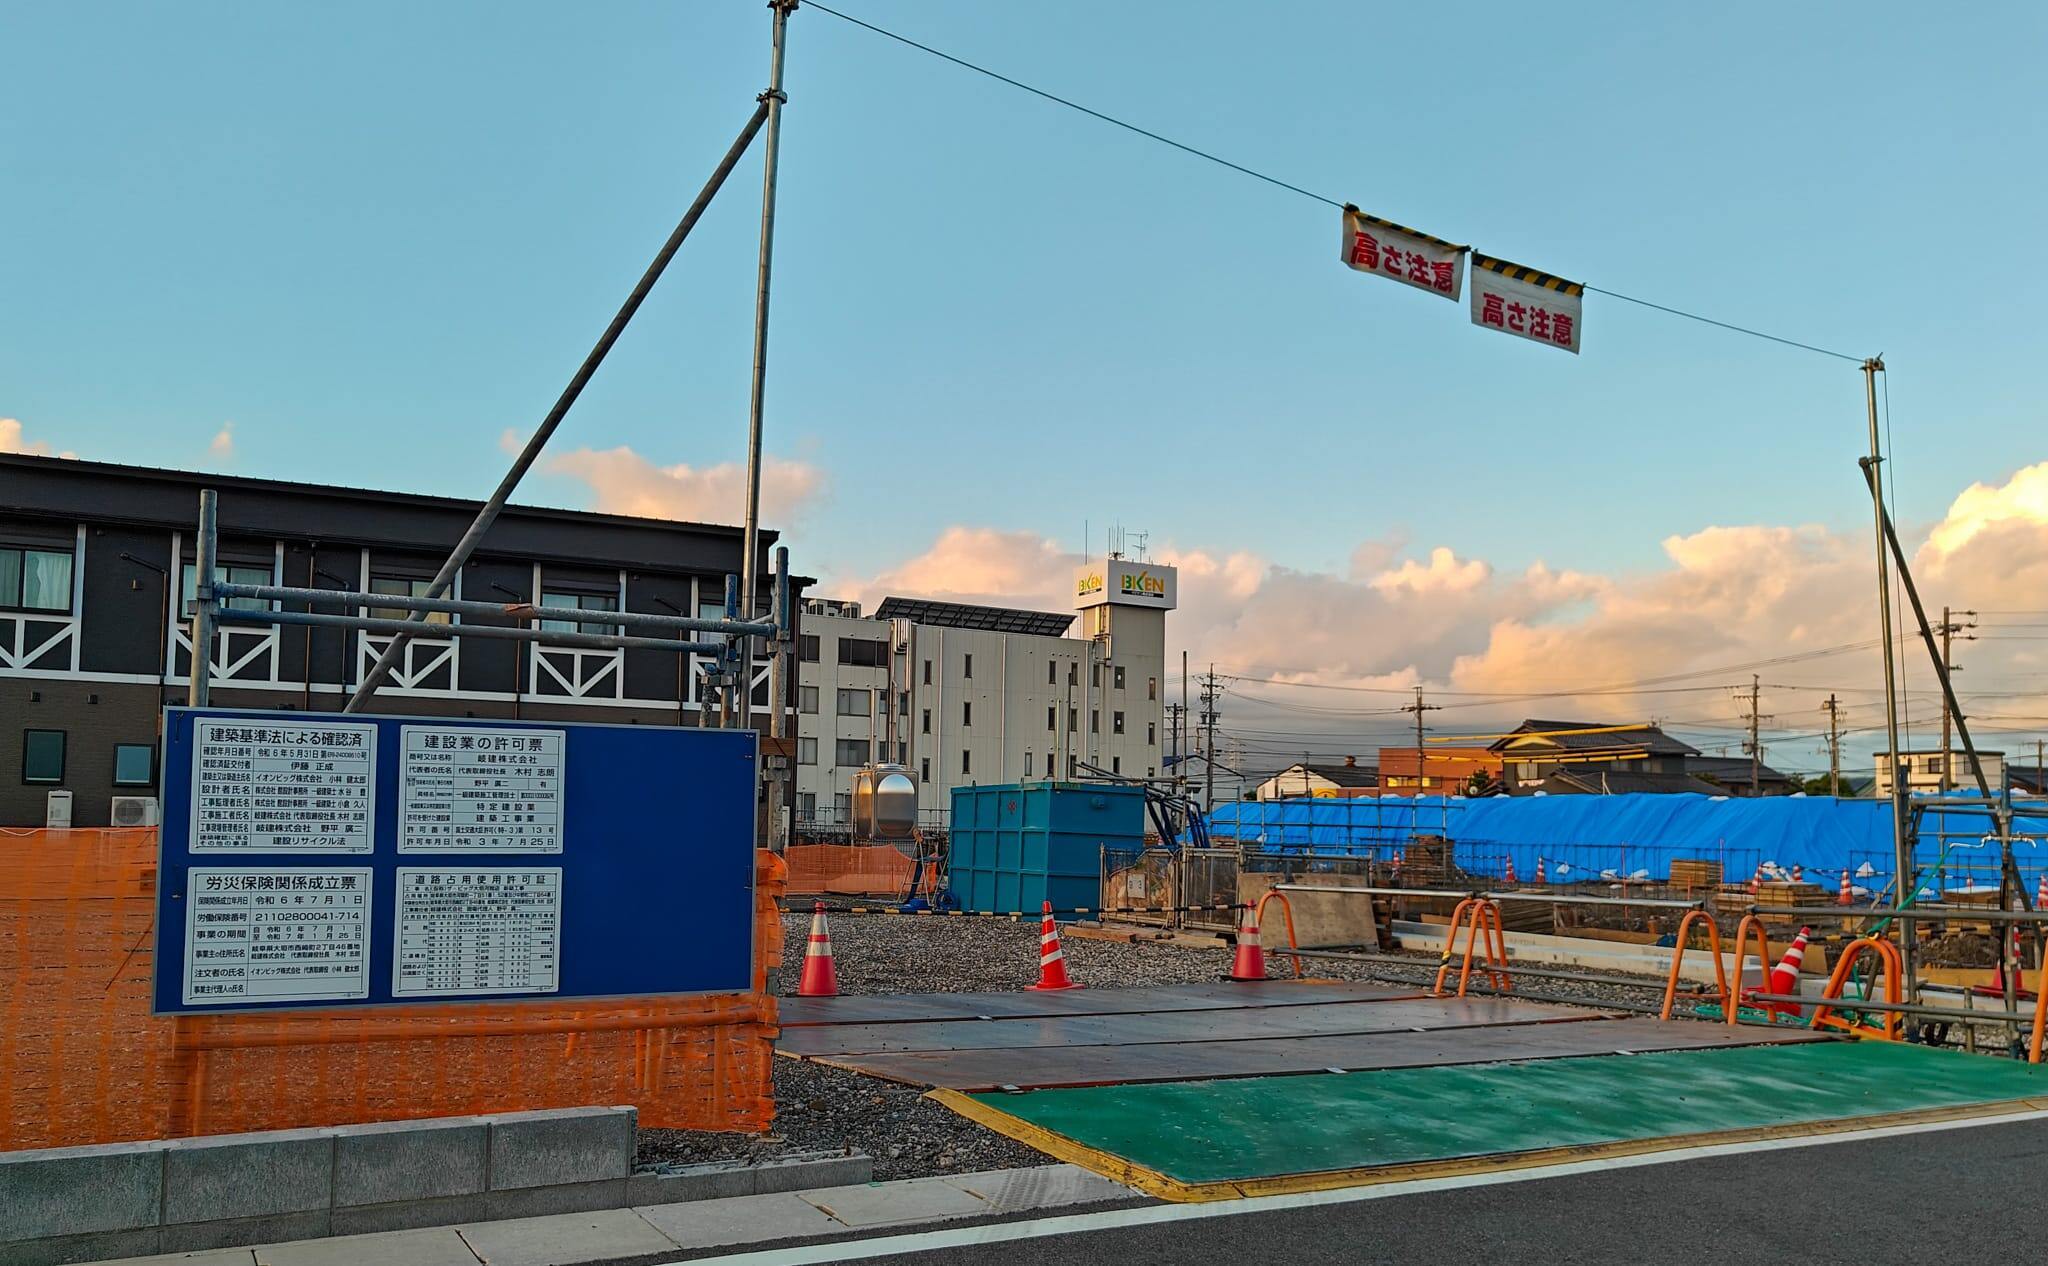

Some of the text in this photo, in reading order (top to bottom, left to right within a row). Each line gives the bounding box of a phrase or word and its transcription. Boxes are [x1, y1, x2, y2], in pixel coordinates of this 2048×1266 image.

[1351, 231, 1454, 293] 高さ注意
[1482, 292, 1573, 345] 高さ注意
[210, 728, 362, 747] 建築基準法による確認済
[424, 735, 543, 751] 建設業の許可票
[203, 747, 251, 757] 確認年月日番号
[409, 754, 452, 762] 商号又は名称
[478, 755, 538, 764] 岐建株式会社
[202, 759, 251, 769] 確認済証交付者
[256, 774, 322, 783] イオンビッグ株式会社
[202, 785, 251, 795] 設計者氏名
[201, 798, 250, 807] 工事監理者氏名
[273, 836, 346, 846] 建設リサイクル法
[206, 876, 357, 890] 労災保険関係成立票
[415, 875, 546, 885] 道路占用使用許可証
[197, 913, 247, 922] 労働保険番号
[255, 912, 359, 922] 21102800041-714
[196, 930, 246, 938] 事業の期間
[195, 969, 245, 978] 注文者の氏名
